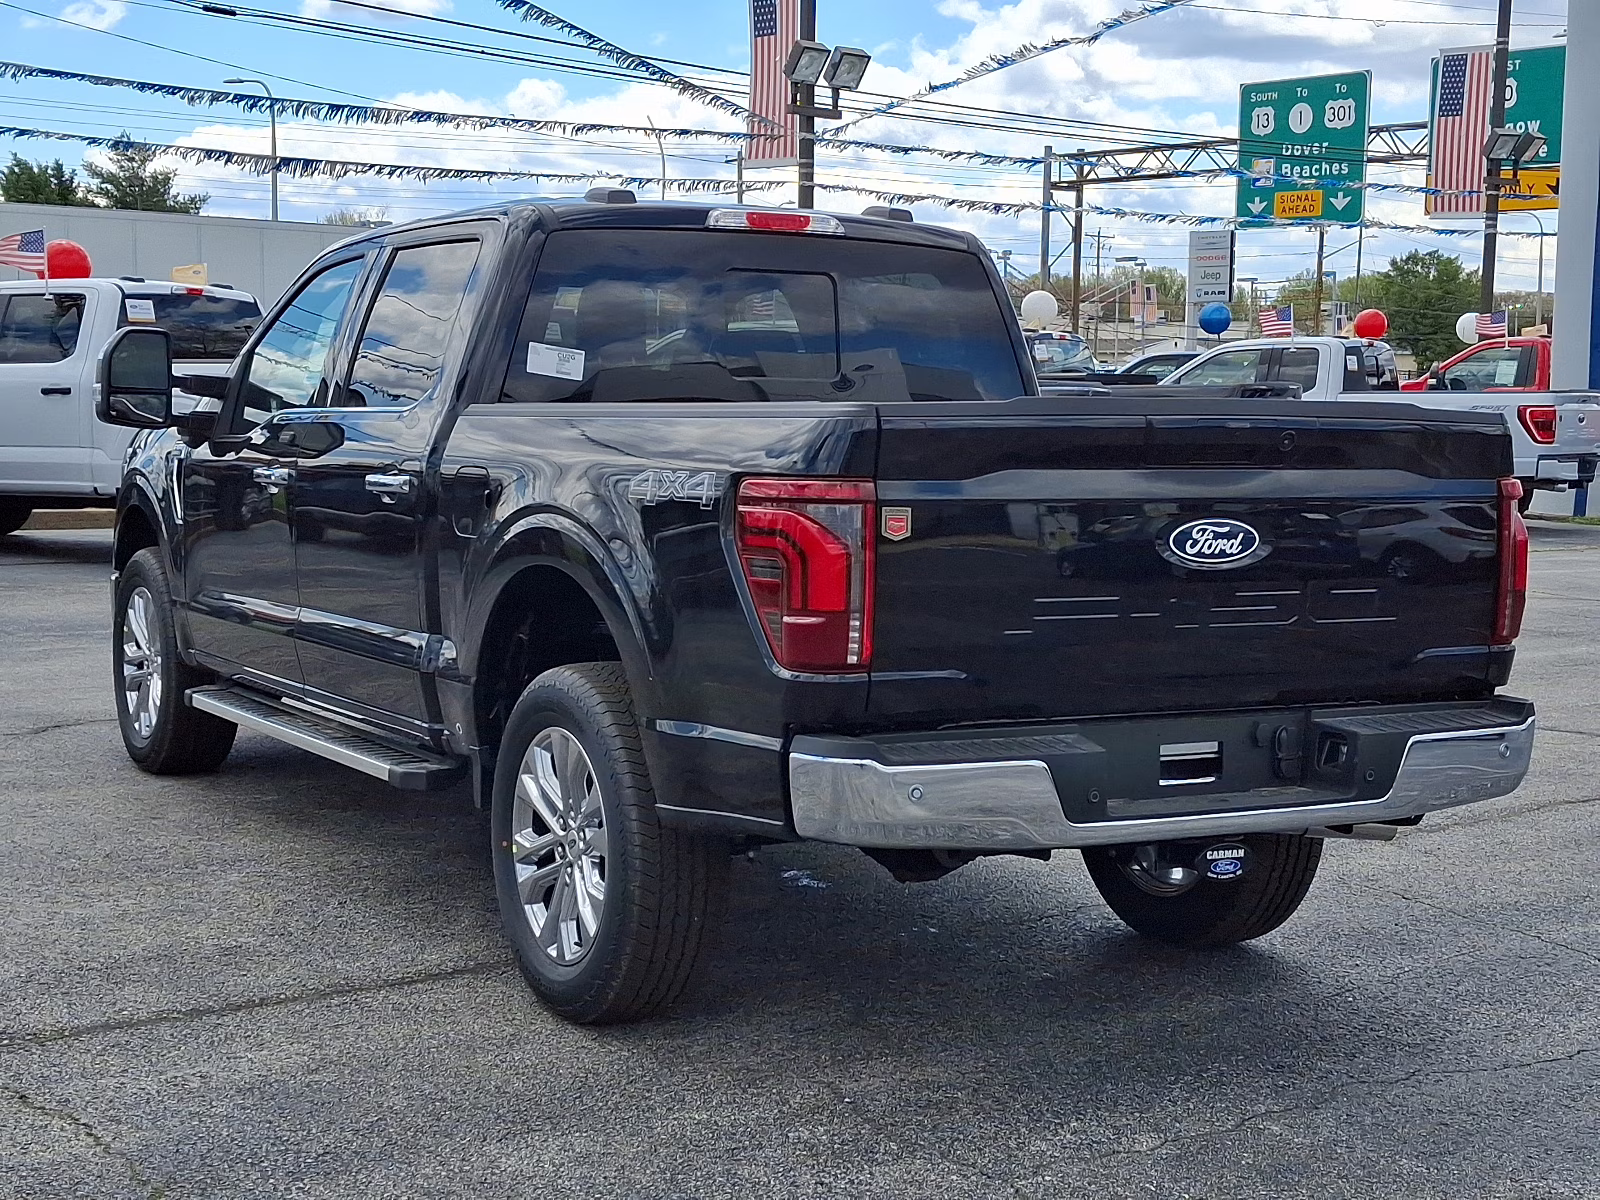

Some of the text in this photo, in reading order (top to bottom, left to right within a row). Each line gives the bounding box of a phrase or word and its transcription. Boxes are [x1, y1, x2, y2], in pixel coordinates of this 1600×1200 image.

[1250, 92, 1278, 102] SOUTH
[1504, 85, 1513, 101] 0
[1299, 110, 1303, 126] 1
[1327, 105, 1351, 122] 301
[1257, 112, 1270, 129] 13
[1282, 142, 1328, 155] Dover
[1281, 162, 1348, 176] Beaches
[1279, 193, 1316, 204] SIGNAL
[1280, 204, 1315, 214] AHEAD
[1200, 270, 1221, 281] Jeep
[1185, 525, 1244, 555] Ford
[1206, 848, 1245, 859] CARMAN
